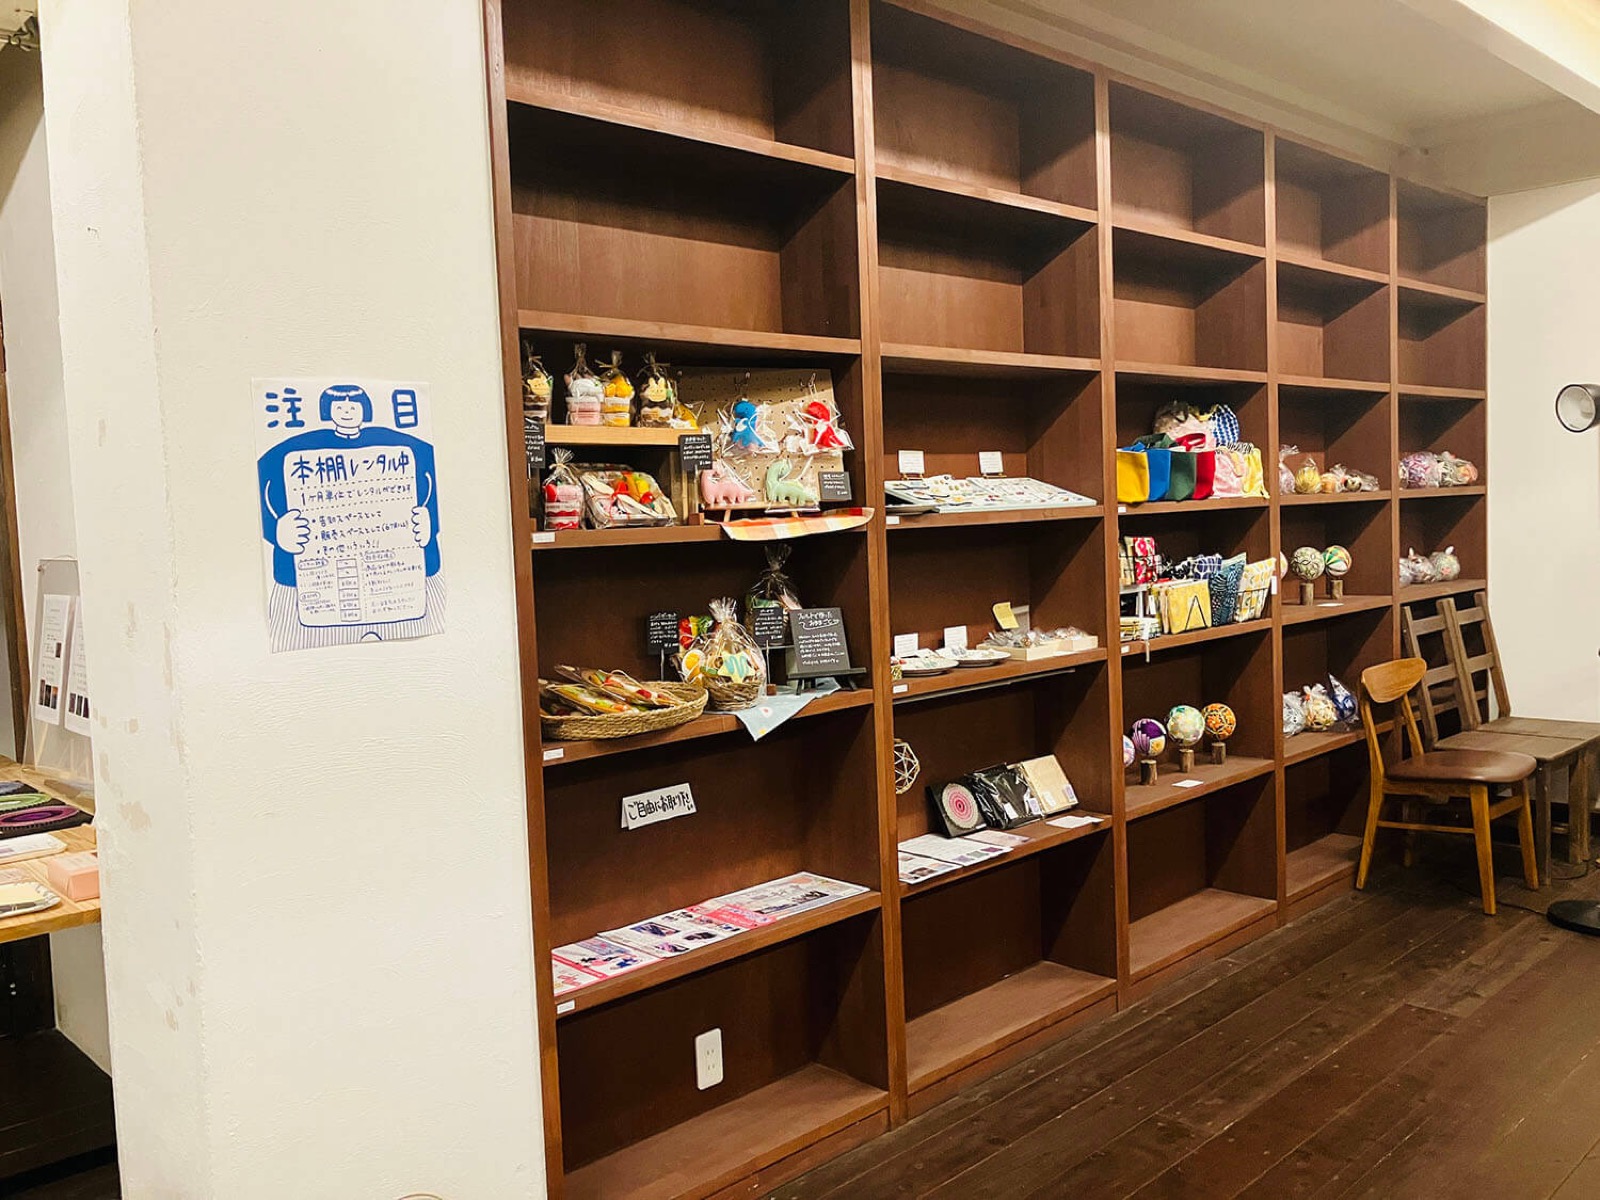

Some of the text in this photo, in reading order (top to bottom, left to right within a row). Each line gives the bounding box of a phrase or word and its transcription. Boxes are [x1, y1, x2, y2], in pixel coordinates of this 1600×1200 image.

[290, 450, 410, 485] 本棚レンタル中
